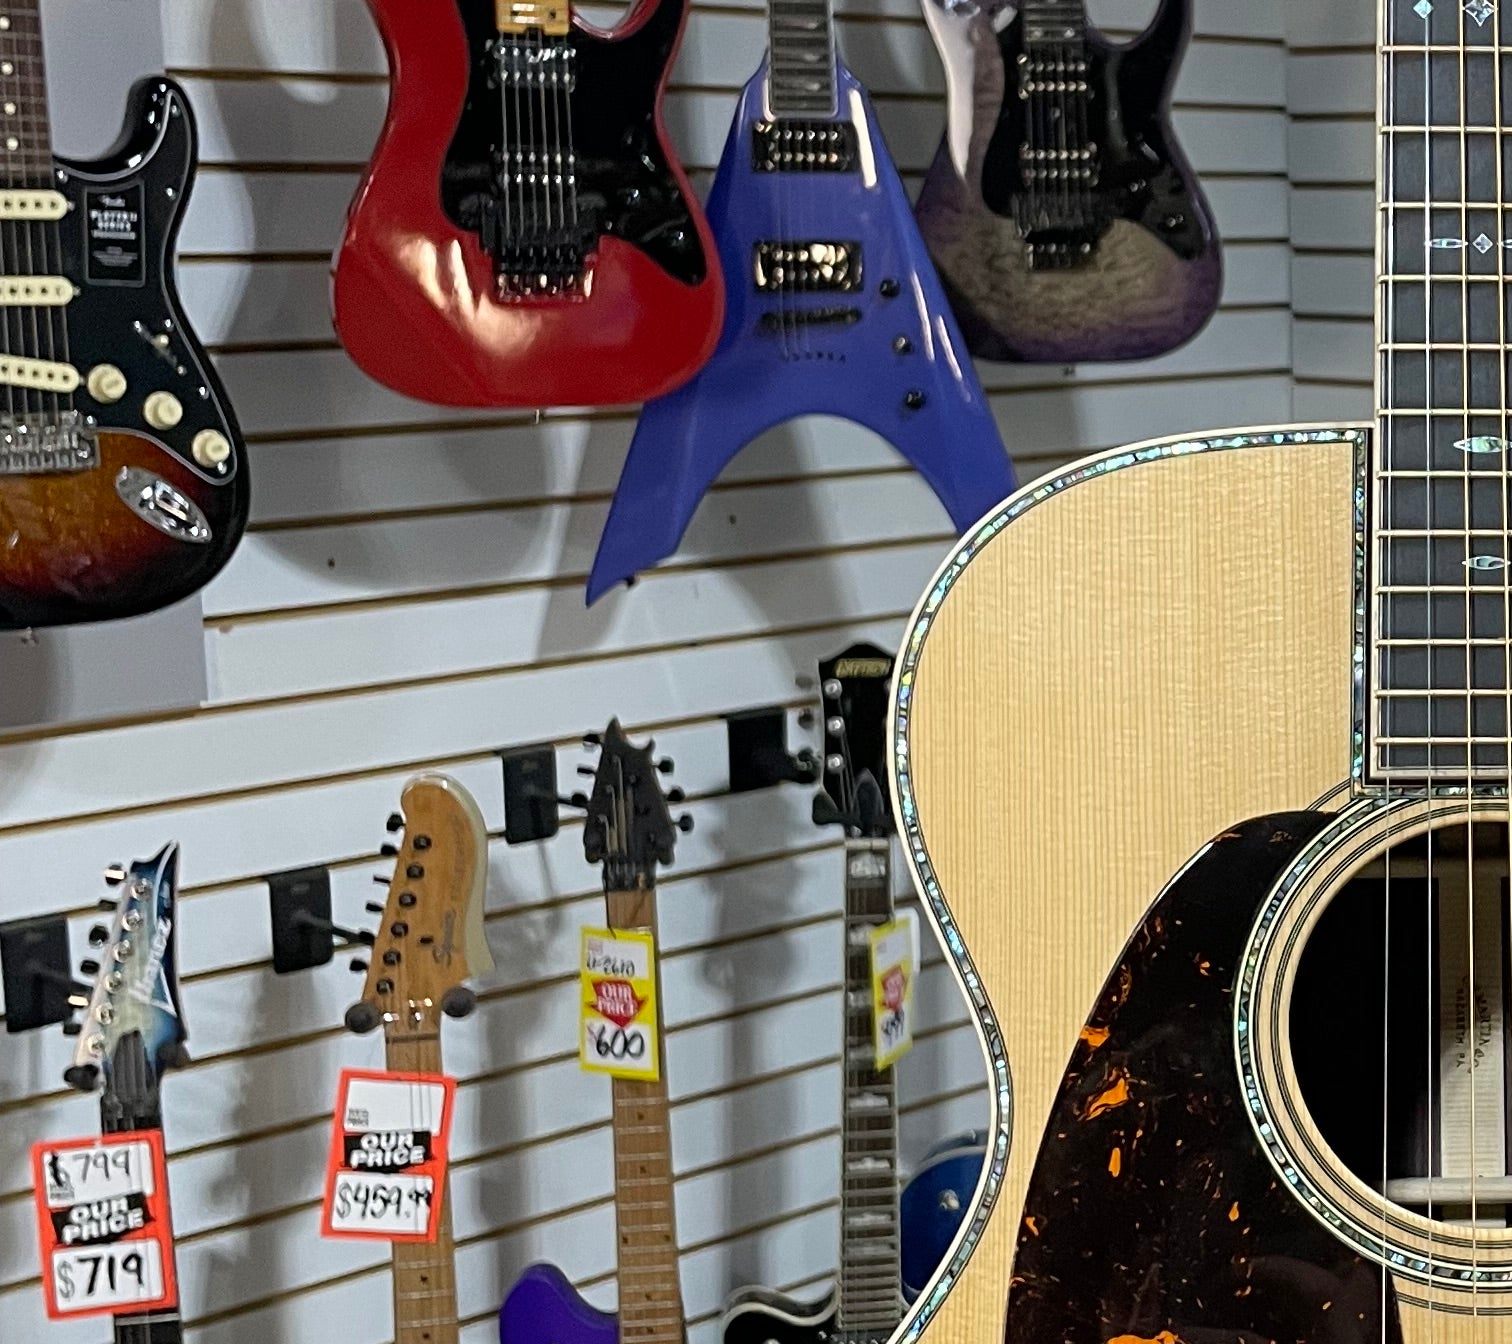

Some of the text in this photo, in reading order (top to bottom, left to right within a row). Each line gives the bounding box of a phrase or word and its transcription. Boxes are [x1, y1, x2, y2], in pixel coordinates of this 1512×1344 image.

[602, 982, 634, 1001] OUR
[360, 1131, 415, 1152] OUR
[350, 1145, 426, 1169] PRICE
[70, 1196, 129, 1224] OUR
[62, 1207, 145, 1246] PRICE
[57, 1253, 145, 1301] $719
